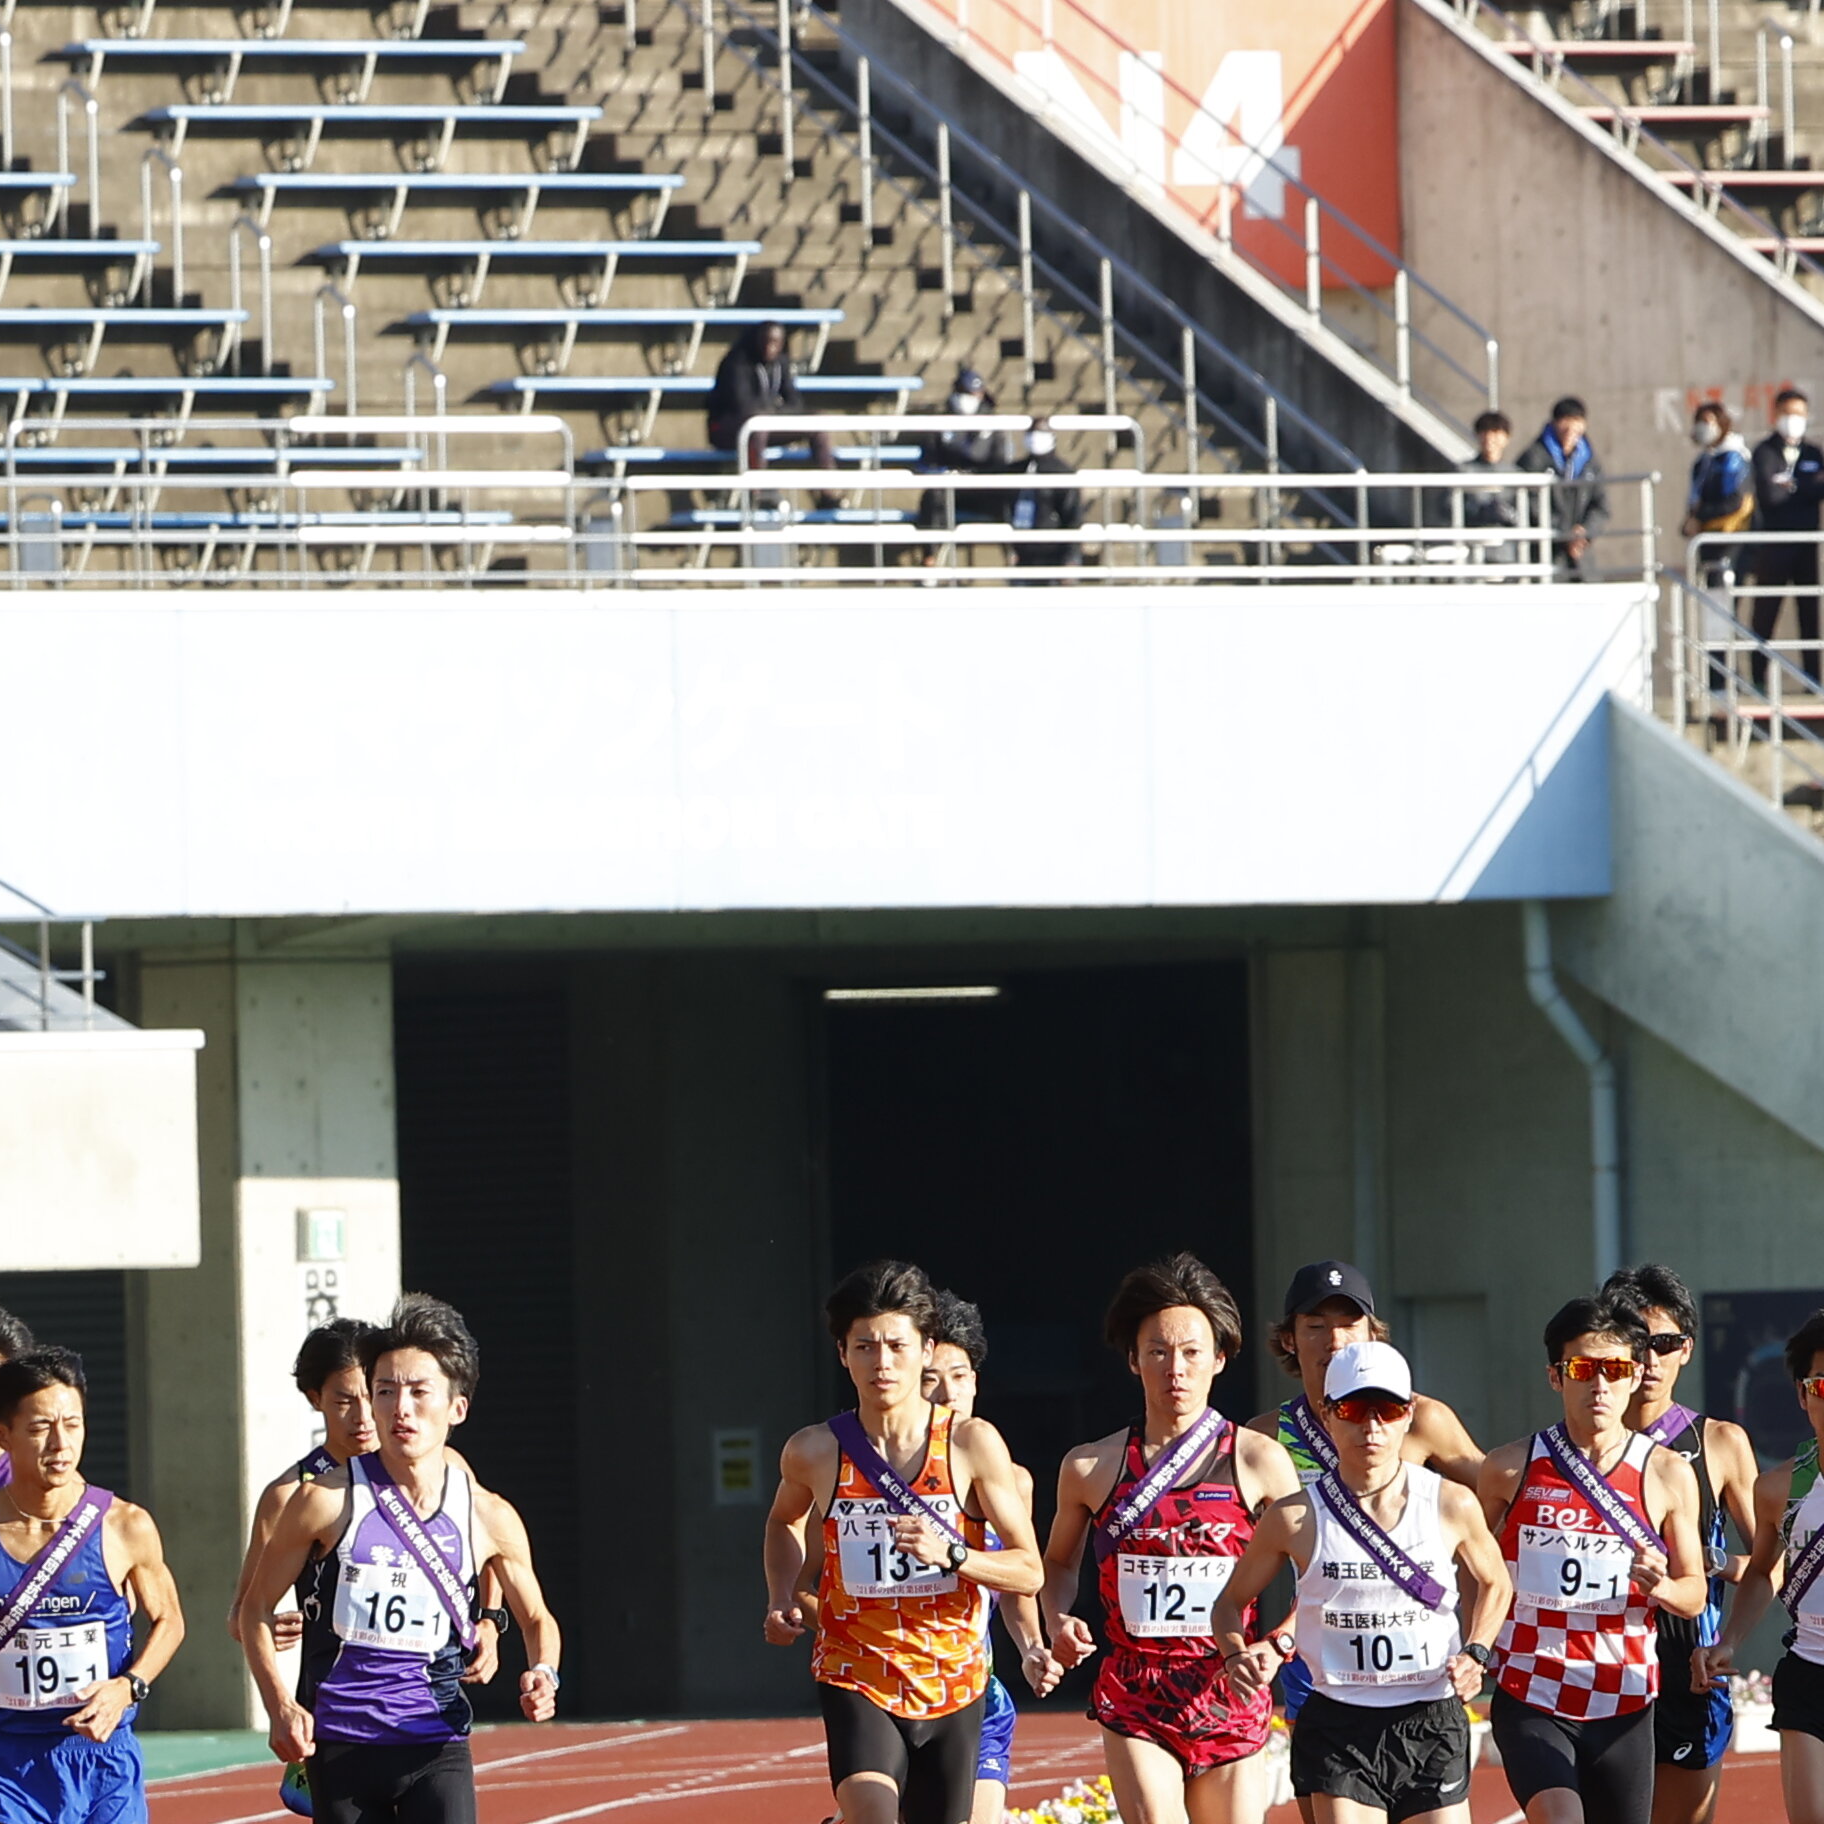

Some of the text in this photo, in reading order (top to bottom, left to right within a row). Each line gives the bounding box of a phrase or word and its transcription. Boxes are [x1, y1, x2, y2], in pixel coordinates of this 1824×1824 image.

[1524, 1528, 1626, 1554] サンベルクス
[1560, 1558, 1618, 1599] 9-1
[365, 1592, 441, 1635] 16-1
[1143, 1583, 1206, 1622] 12-
[1350, 1634, 1430, 1672] 10-1
[15, 1655, 96, 1695] 19-1
